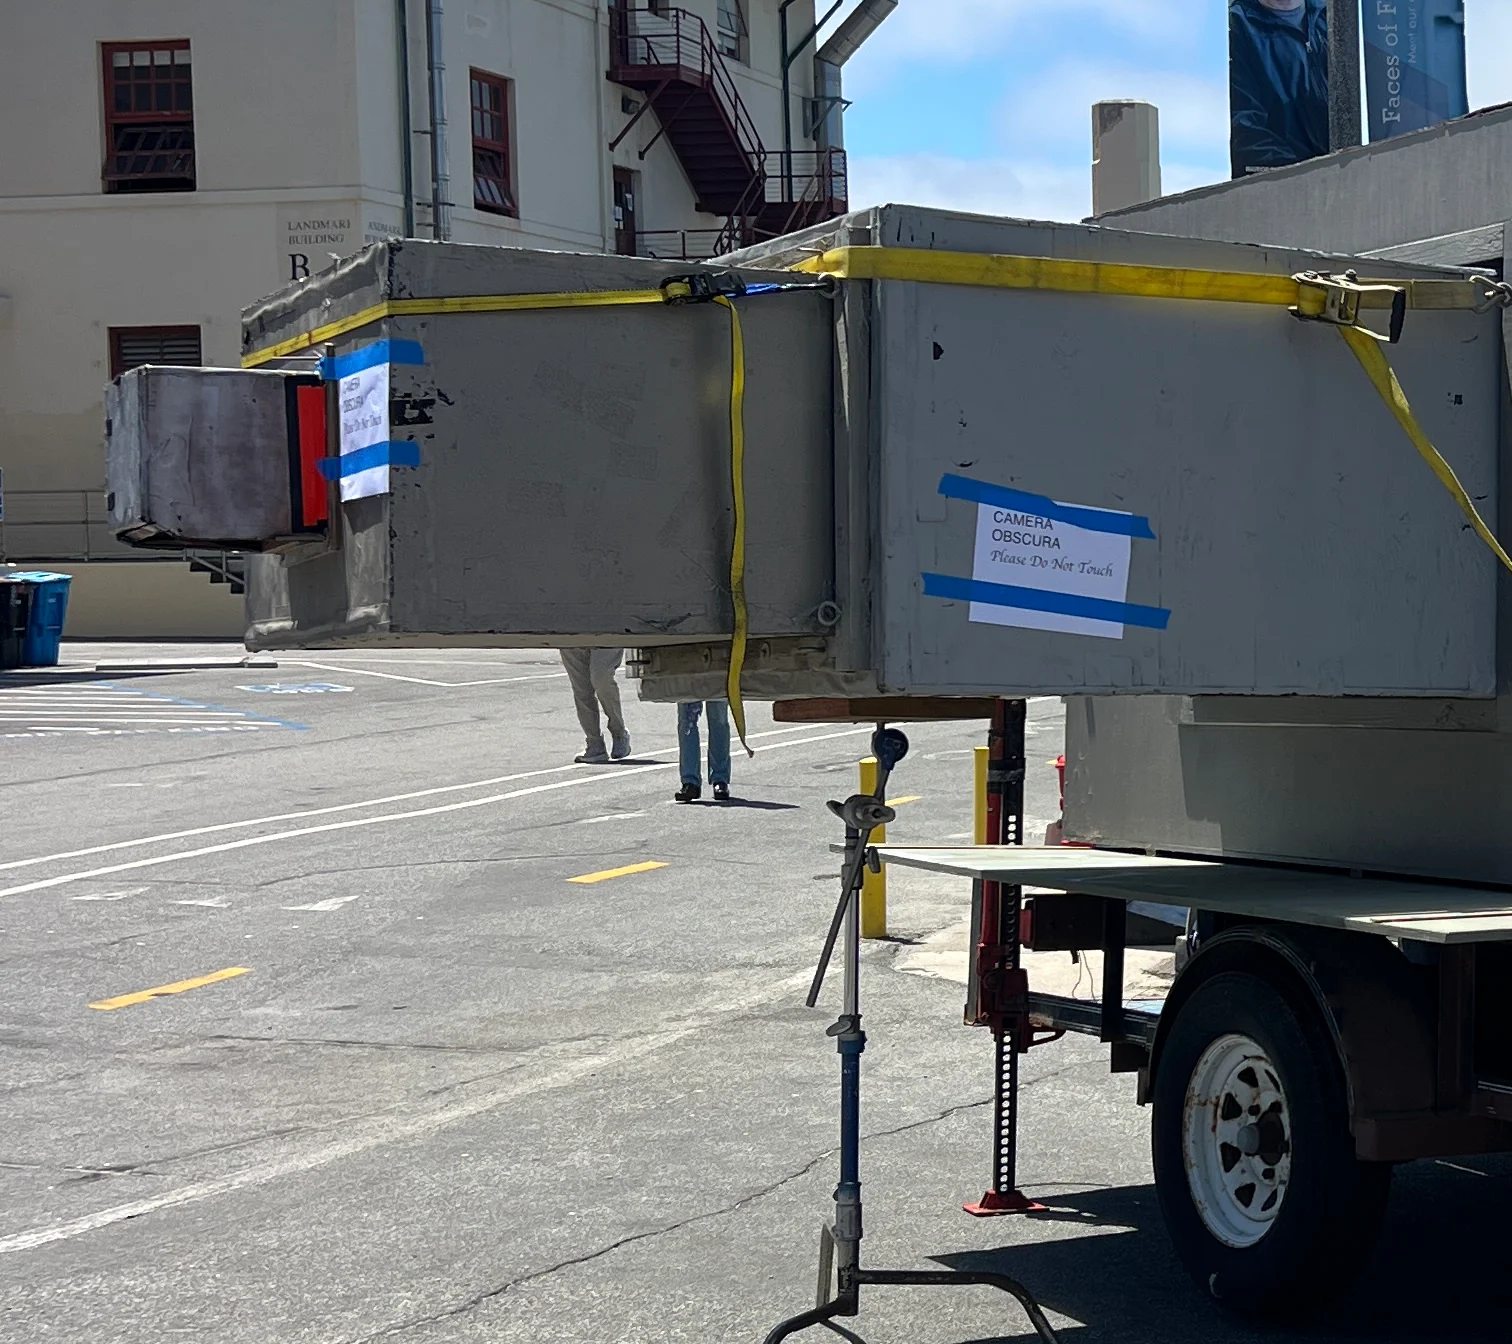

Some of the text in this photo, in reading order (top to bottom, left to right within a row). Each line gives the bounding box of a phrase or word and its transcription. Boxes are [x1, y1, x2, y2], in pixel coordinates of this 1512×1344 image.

[1408, 10, 1417, 29] our
[1377, 23, 1399, 47] of
[1408, 33, 1417, 64] Meet
[1382, 55, 1401, 124] Faces
[288, 234, 345, 245] BUILDING
[288, 253, 310, 281] B
[993, 510, 1054, 530] CAMERA
[992, 528, 1061, 549] OBSCURA
[990, 549, 1113, 577] Please Do Not Touch
